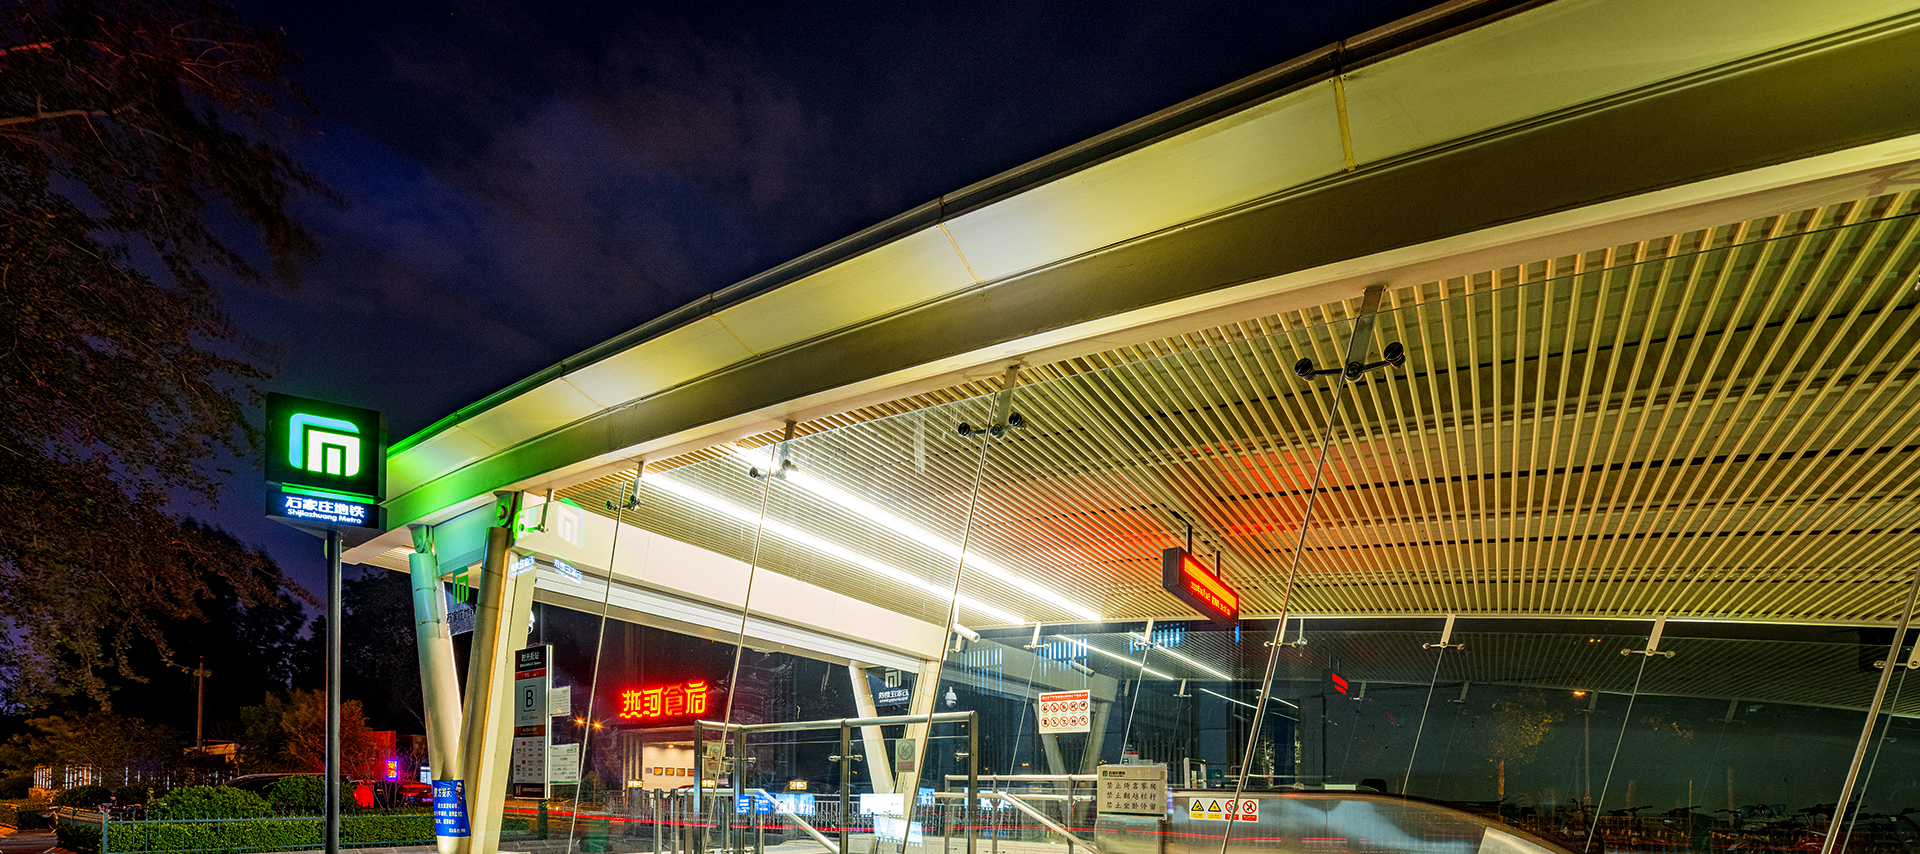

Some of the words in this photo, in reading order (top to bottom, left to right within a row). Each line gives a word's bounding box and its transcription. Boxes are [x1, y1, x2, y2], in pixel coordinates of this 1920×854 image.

[285, 495, 364, 518] 石家庄地铁
[287, 508, 338, 522] Shijiazhuang
[338, 514, 362, 524] Metro
[525, 689, 533, 708] B
[1106, 781, 1157, 790] 禁止倚靠攀爬
[1106, 791, 1157, 801] 禁止翻越栏杆
[1106, 801, 1157, 811] 禁止坐卧停留
